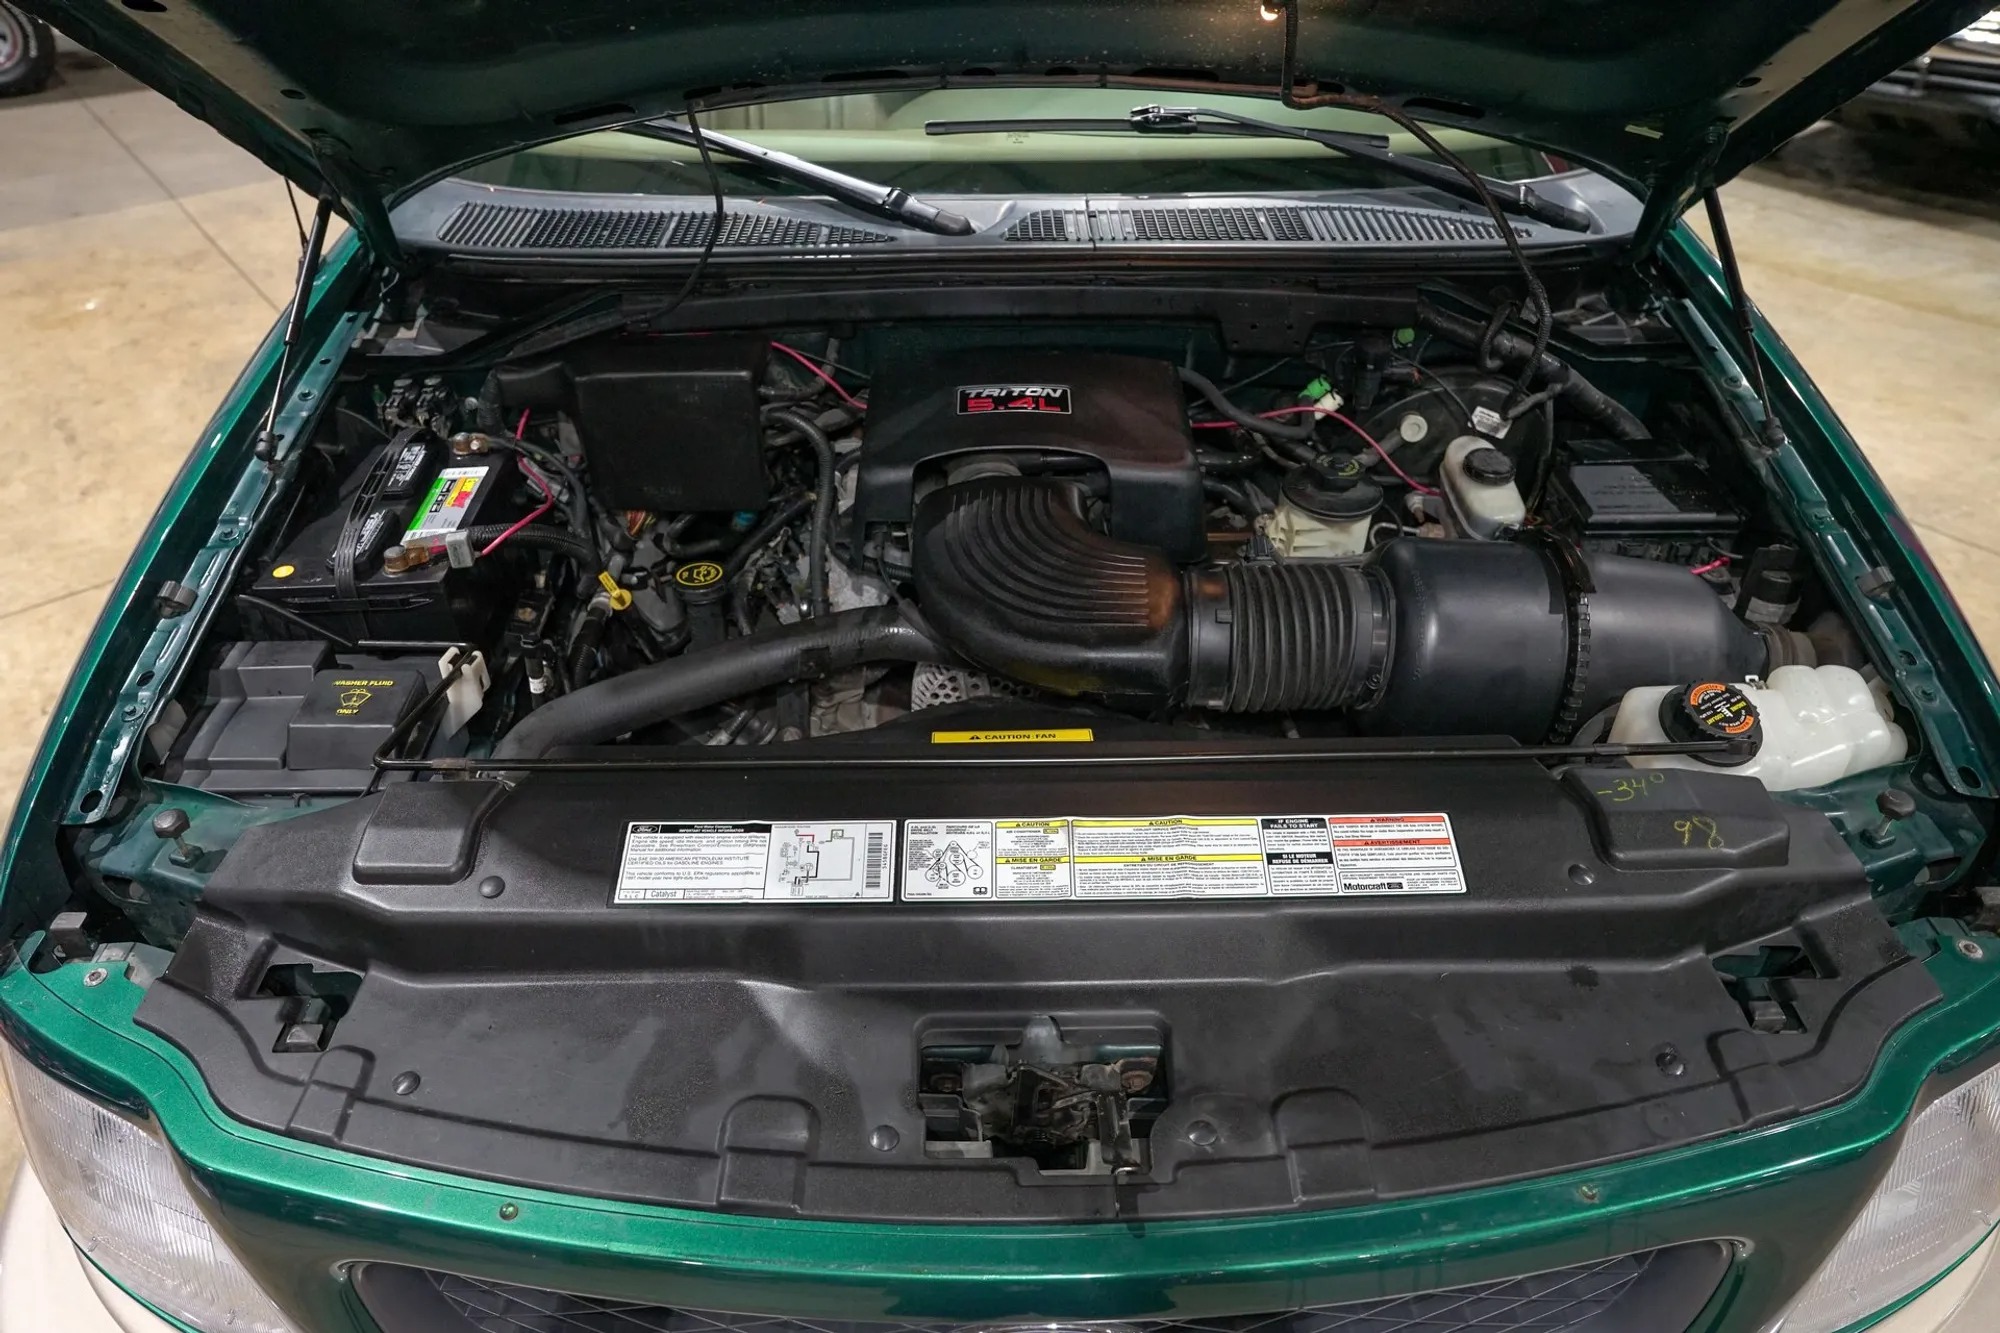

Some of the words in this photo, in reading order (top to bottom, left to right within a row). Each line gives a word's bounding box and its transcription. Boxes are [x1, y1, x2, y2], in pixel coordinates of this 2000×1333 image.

[965, 388, 1062, 398] TRITON
[968, 397, 1060, 411] 5.4L
[1674, 816, 1724, 850] 98
